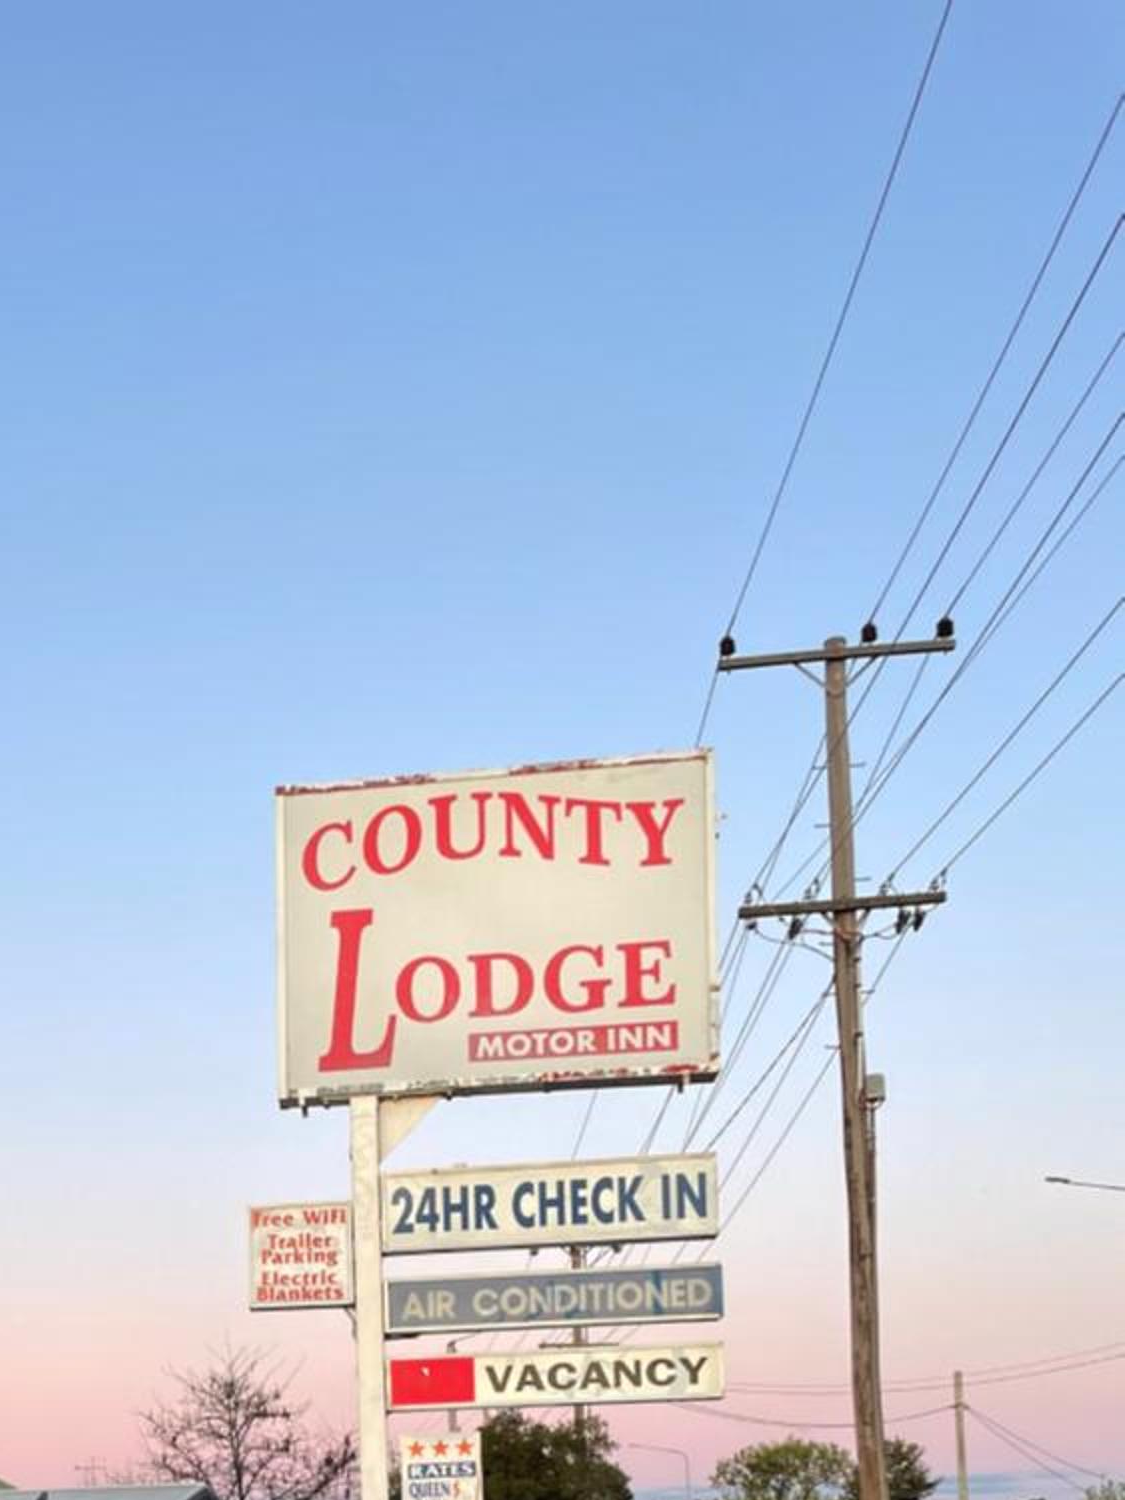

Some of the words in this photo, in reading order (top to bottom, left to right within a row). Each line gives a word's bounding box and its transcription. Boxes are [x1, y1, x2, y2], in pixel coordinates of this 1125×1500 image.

[301, 791, 686, 891] COUNTY
[318, 908, 677, 1073] LODGE
[477, 1028, 597, 1058] MOTOR
[607, 1023, 672, 1051] INN
[391, 1183, 498, 1235] 24HR
[512, 1174, 646, 1229] CHECK
[661, 1171, 708, 1220] IN
[251, 1208, 294, 1228] Free
[267, 1232, 332, 1249] Trailer
[260, 1248, 338, 1267] Parking
[261, 1269, 337, 1286] Electric
[256, 1286, 344, 1301] Blankets
[401, 1290, 456, 1321] AIR
[473, 1278, 712, 1318] CONDITIONED
[485, 1356, 709, 1393] VACANCY
[410, 1461, 474, 1479] RATES
[409, 1481, 451, 1499] QUEEN
